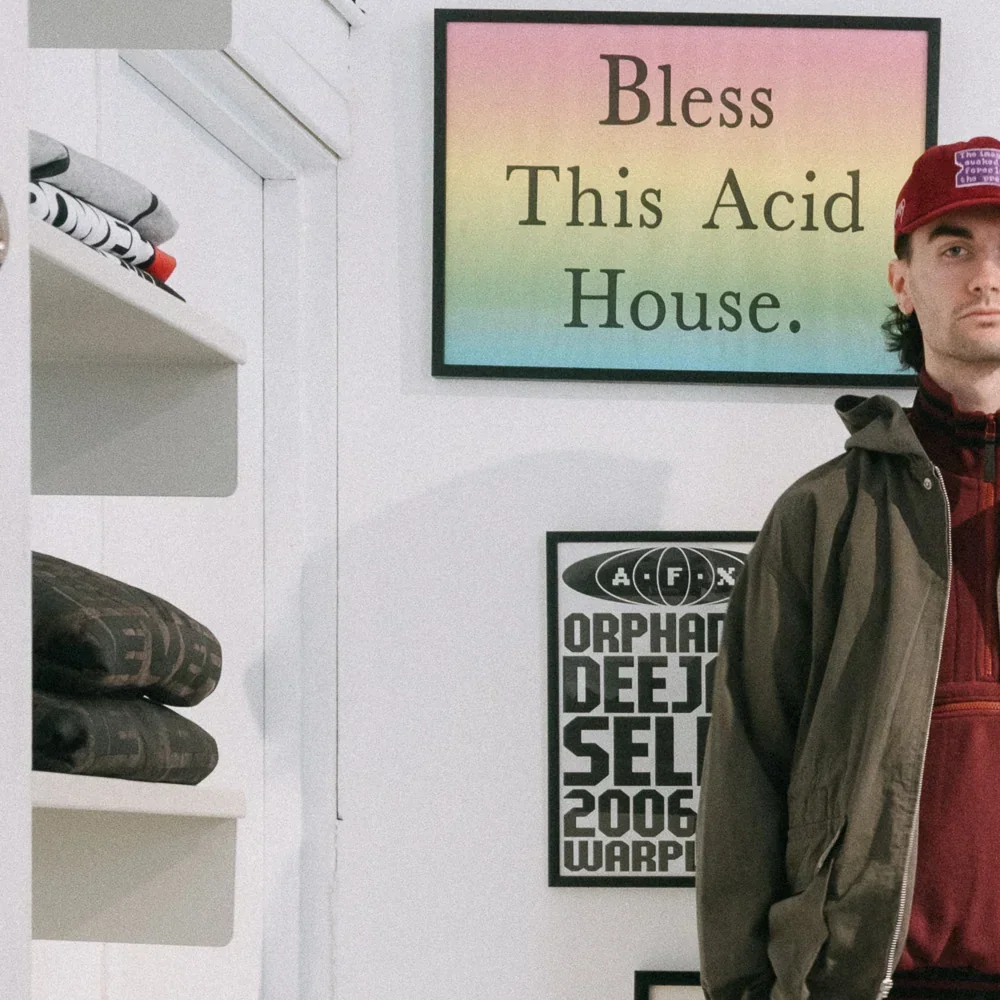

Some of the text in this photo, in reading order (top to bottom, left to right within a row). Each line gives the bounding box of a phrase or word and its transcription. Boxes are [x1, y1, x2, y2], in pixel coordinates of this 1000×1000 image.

[599, 53, 775, 129] Bless
[960, 151, 977, 159] The
[505, 165, 664, 229] This
[701, 167, 865, 233] Acid
[563, 267, 802, 334] House.
[562, 715, 713, 787] SEL
[563, 789, 698, 838] 2006
